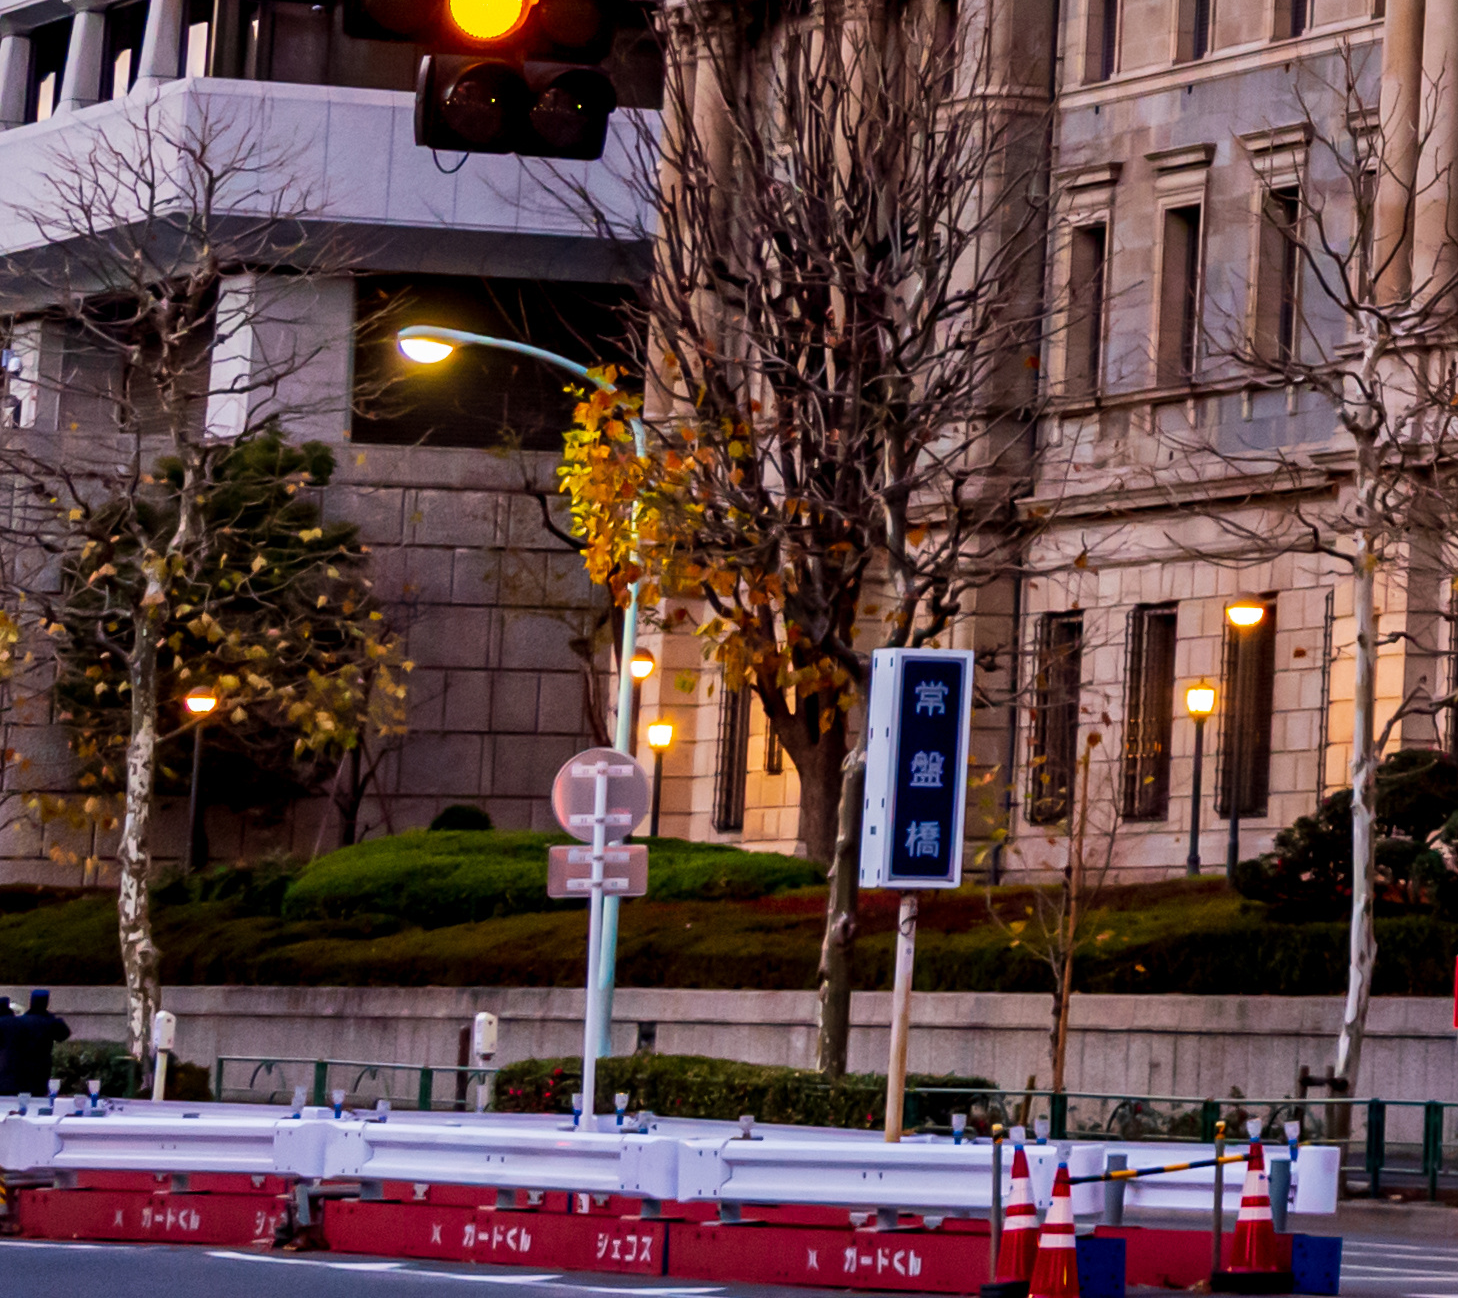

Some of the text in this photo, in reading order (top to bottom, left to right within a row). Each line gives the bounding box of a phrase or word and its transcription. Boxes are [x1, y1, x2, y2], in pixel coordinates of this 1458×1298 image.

[904, 680, 950, 859] 常盤橋
[462, 1222, 532, 1253] ガードくん
[843, 1247, 922, 1277] ガードくん
